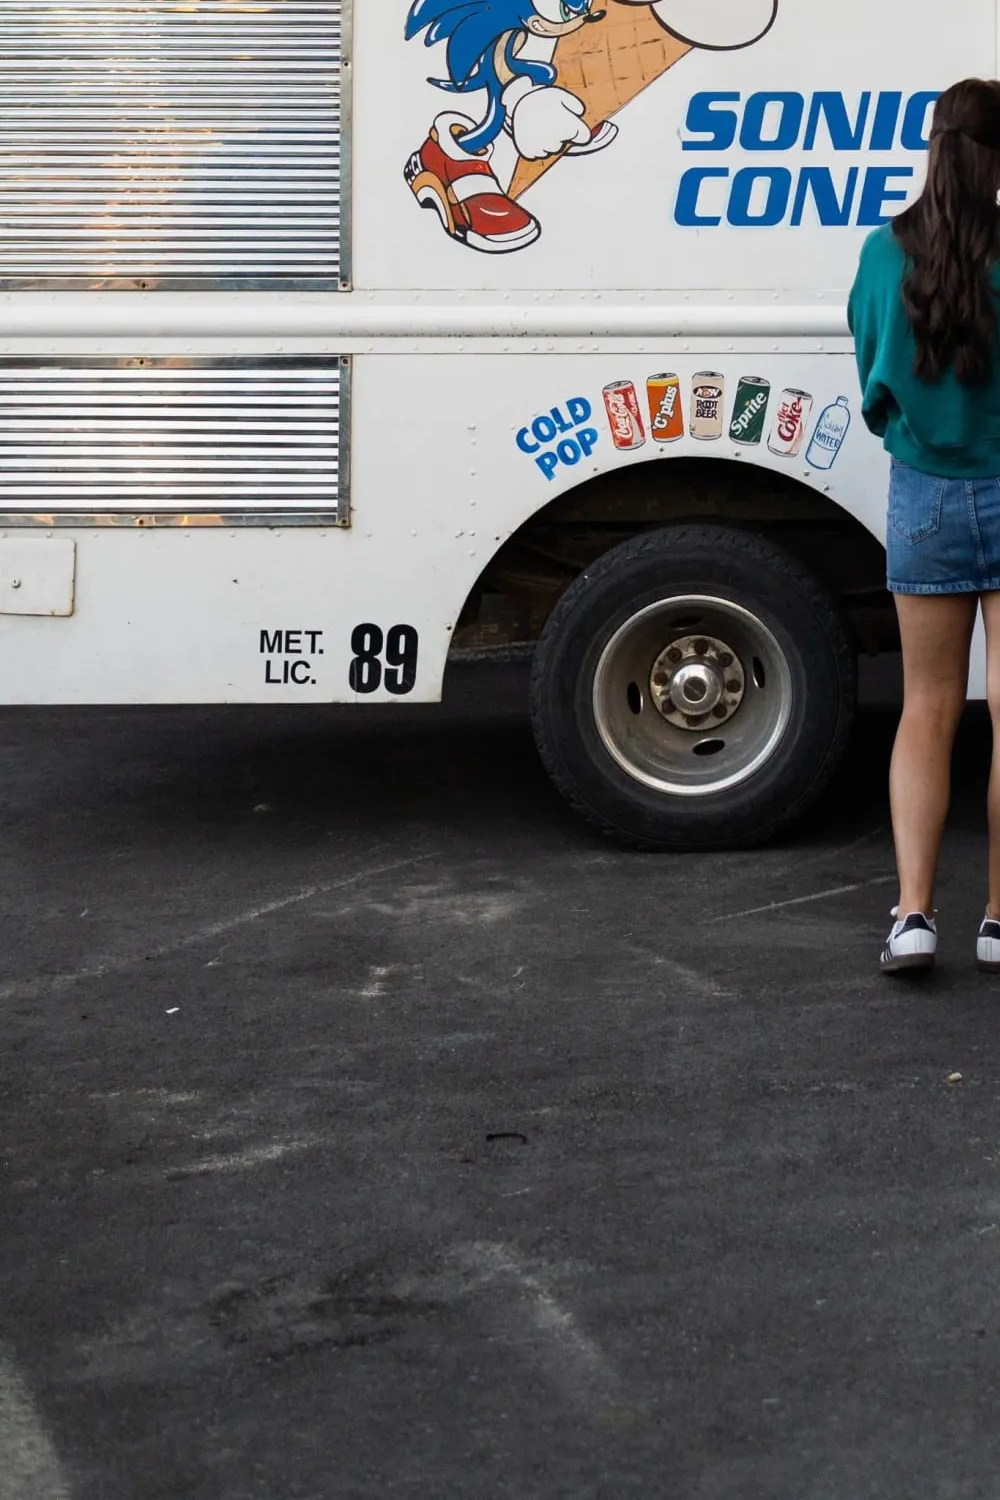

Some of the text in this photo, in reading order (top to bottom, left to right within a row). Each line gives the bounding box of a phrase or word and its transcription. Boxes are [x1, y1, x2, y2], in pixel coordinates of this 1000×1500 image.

[681, 91, 944, 151] SONIC
[673, 167, 914, 227] CONE
[515, 396, 592, 454] COLD
[695, 408, 718, 420] BEER
[696, 399, 718, 410] ROOT
[730, 392, 767, 436] Sprite
[778, 397, 802, 442] Coke
[533, 427, 599, 481] POP
[815, 430, 841, 449] WATER
[259, 629, 325, 655] MET.
[264, 622, 419, 695] LIC. 89
